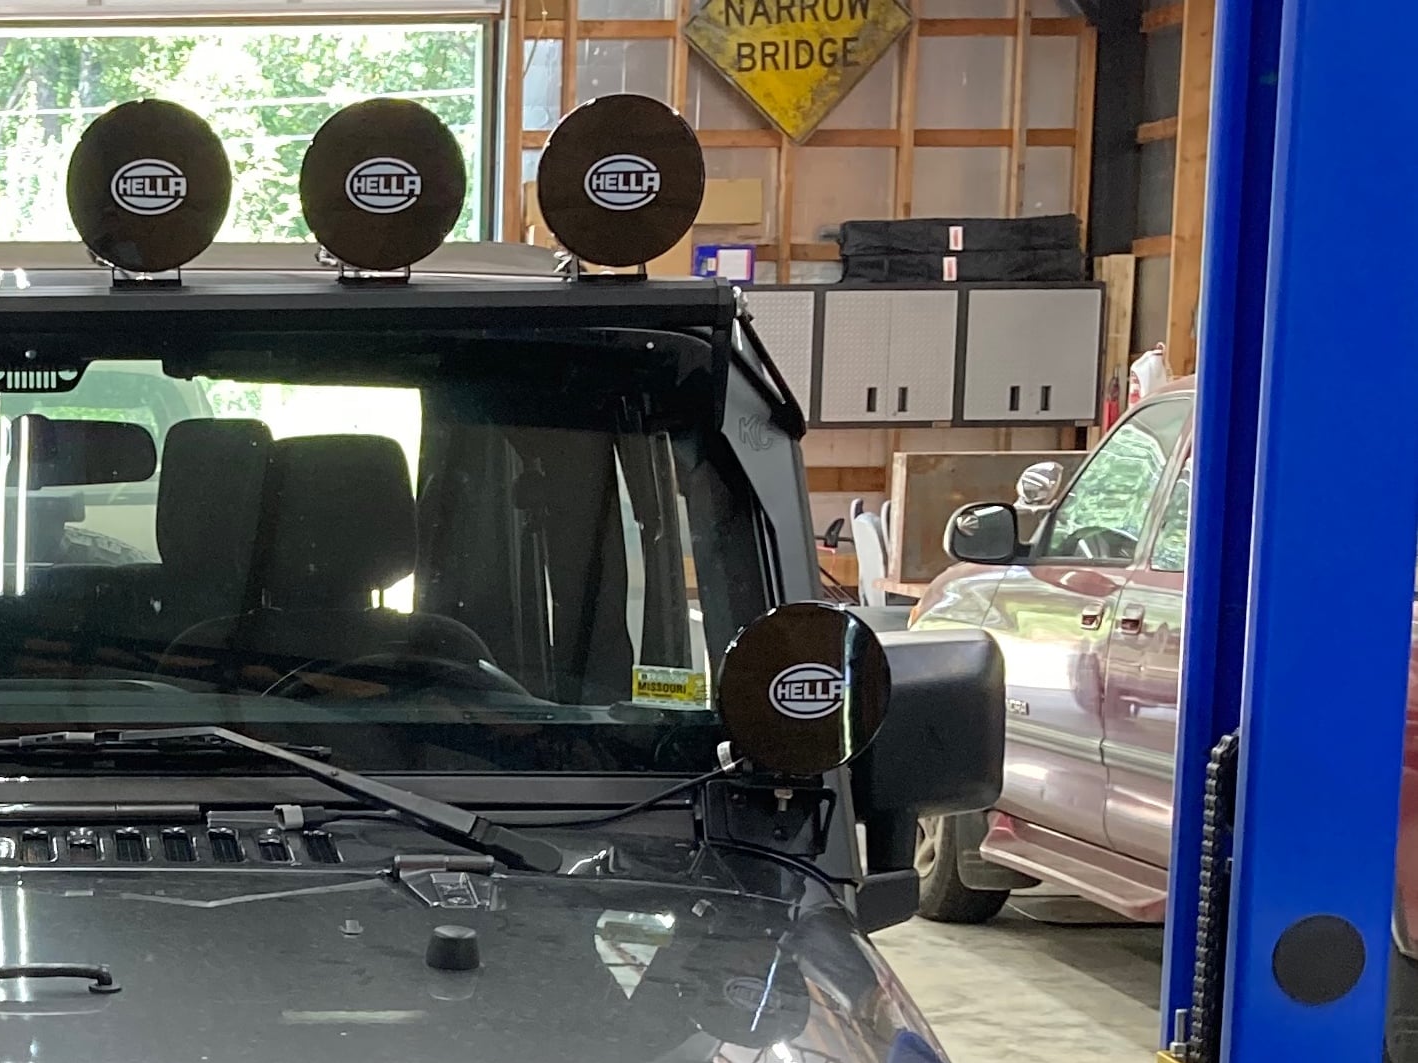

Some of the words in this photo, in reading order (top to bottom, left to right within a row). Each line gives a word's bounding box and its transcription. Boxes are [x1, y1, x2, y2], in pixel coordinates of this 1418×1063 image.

[724, 0, 870, 26] NARROW
[737, 36, 861, 73] BRIDGE
[119, 176, 187, 197] HELLA
[353, 175, 422, 195] HELLA
[592, 172, 661, 192] HELLA
[738, 412, 775, 452] KC
[637, 681, 687, 694] MISSOURI
[776, 680, 846, 700] HELLA
